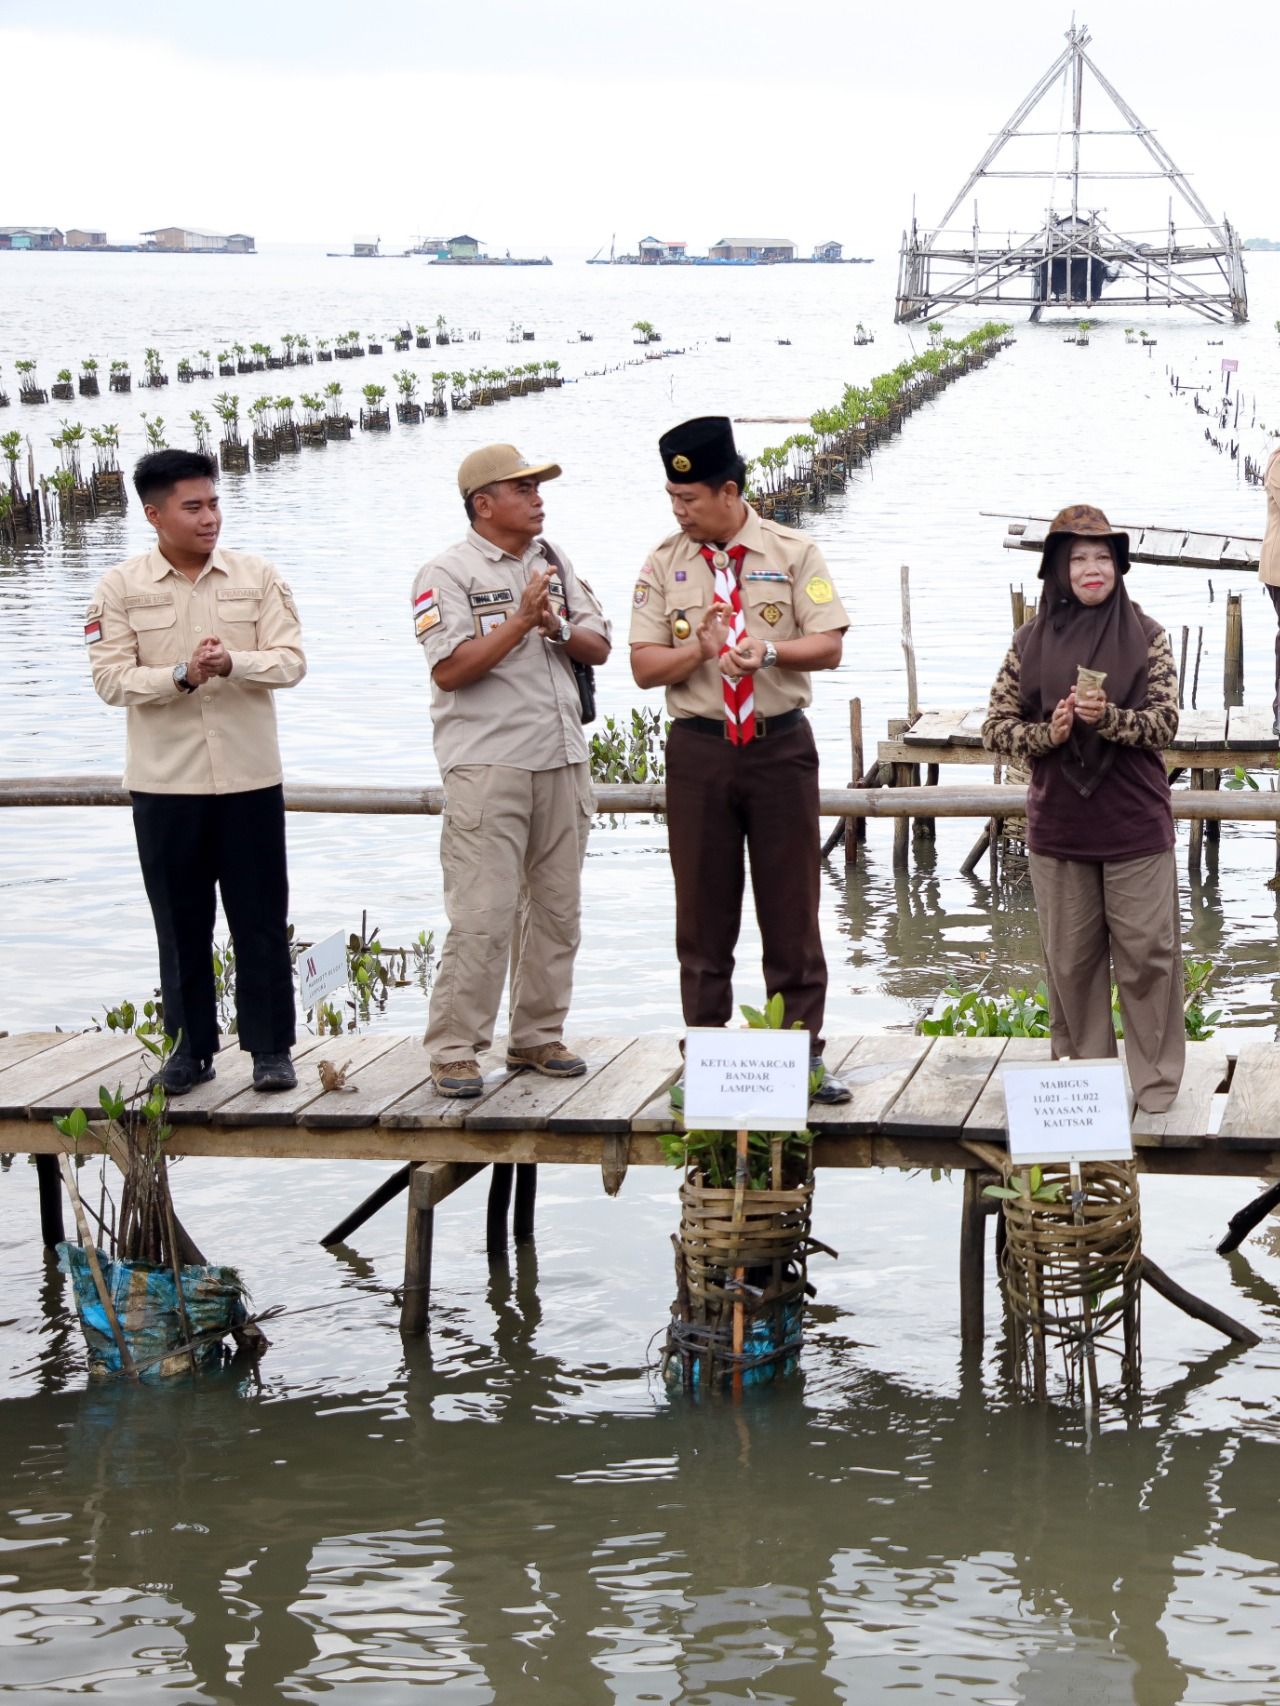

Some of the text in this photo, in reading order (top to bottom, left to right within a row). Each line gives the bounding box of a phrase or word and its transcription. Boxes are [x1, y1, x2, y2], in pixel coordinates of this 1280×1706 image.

[701, 1059, 796, 1069] KETUA KWARCAB
[725, 1072, 770, 1081] BANDAR
[720, 1084, 774, 1093] LAMPUNG
[1040, 1080, 1089, 1089] MABIGUS
[1034, 1105, 1101, 1116] YAYASAN AL
[1043, 1118, 1094, 1128] KAUTSAR
